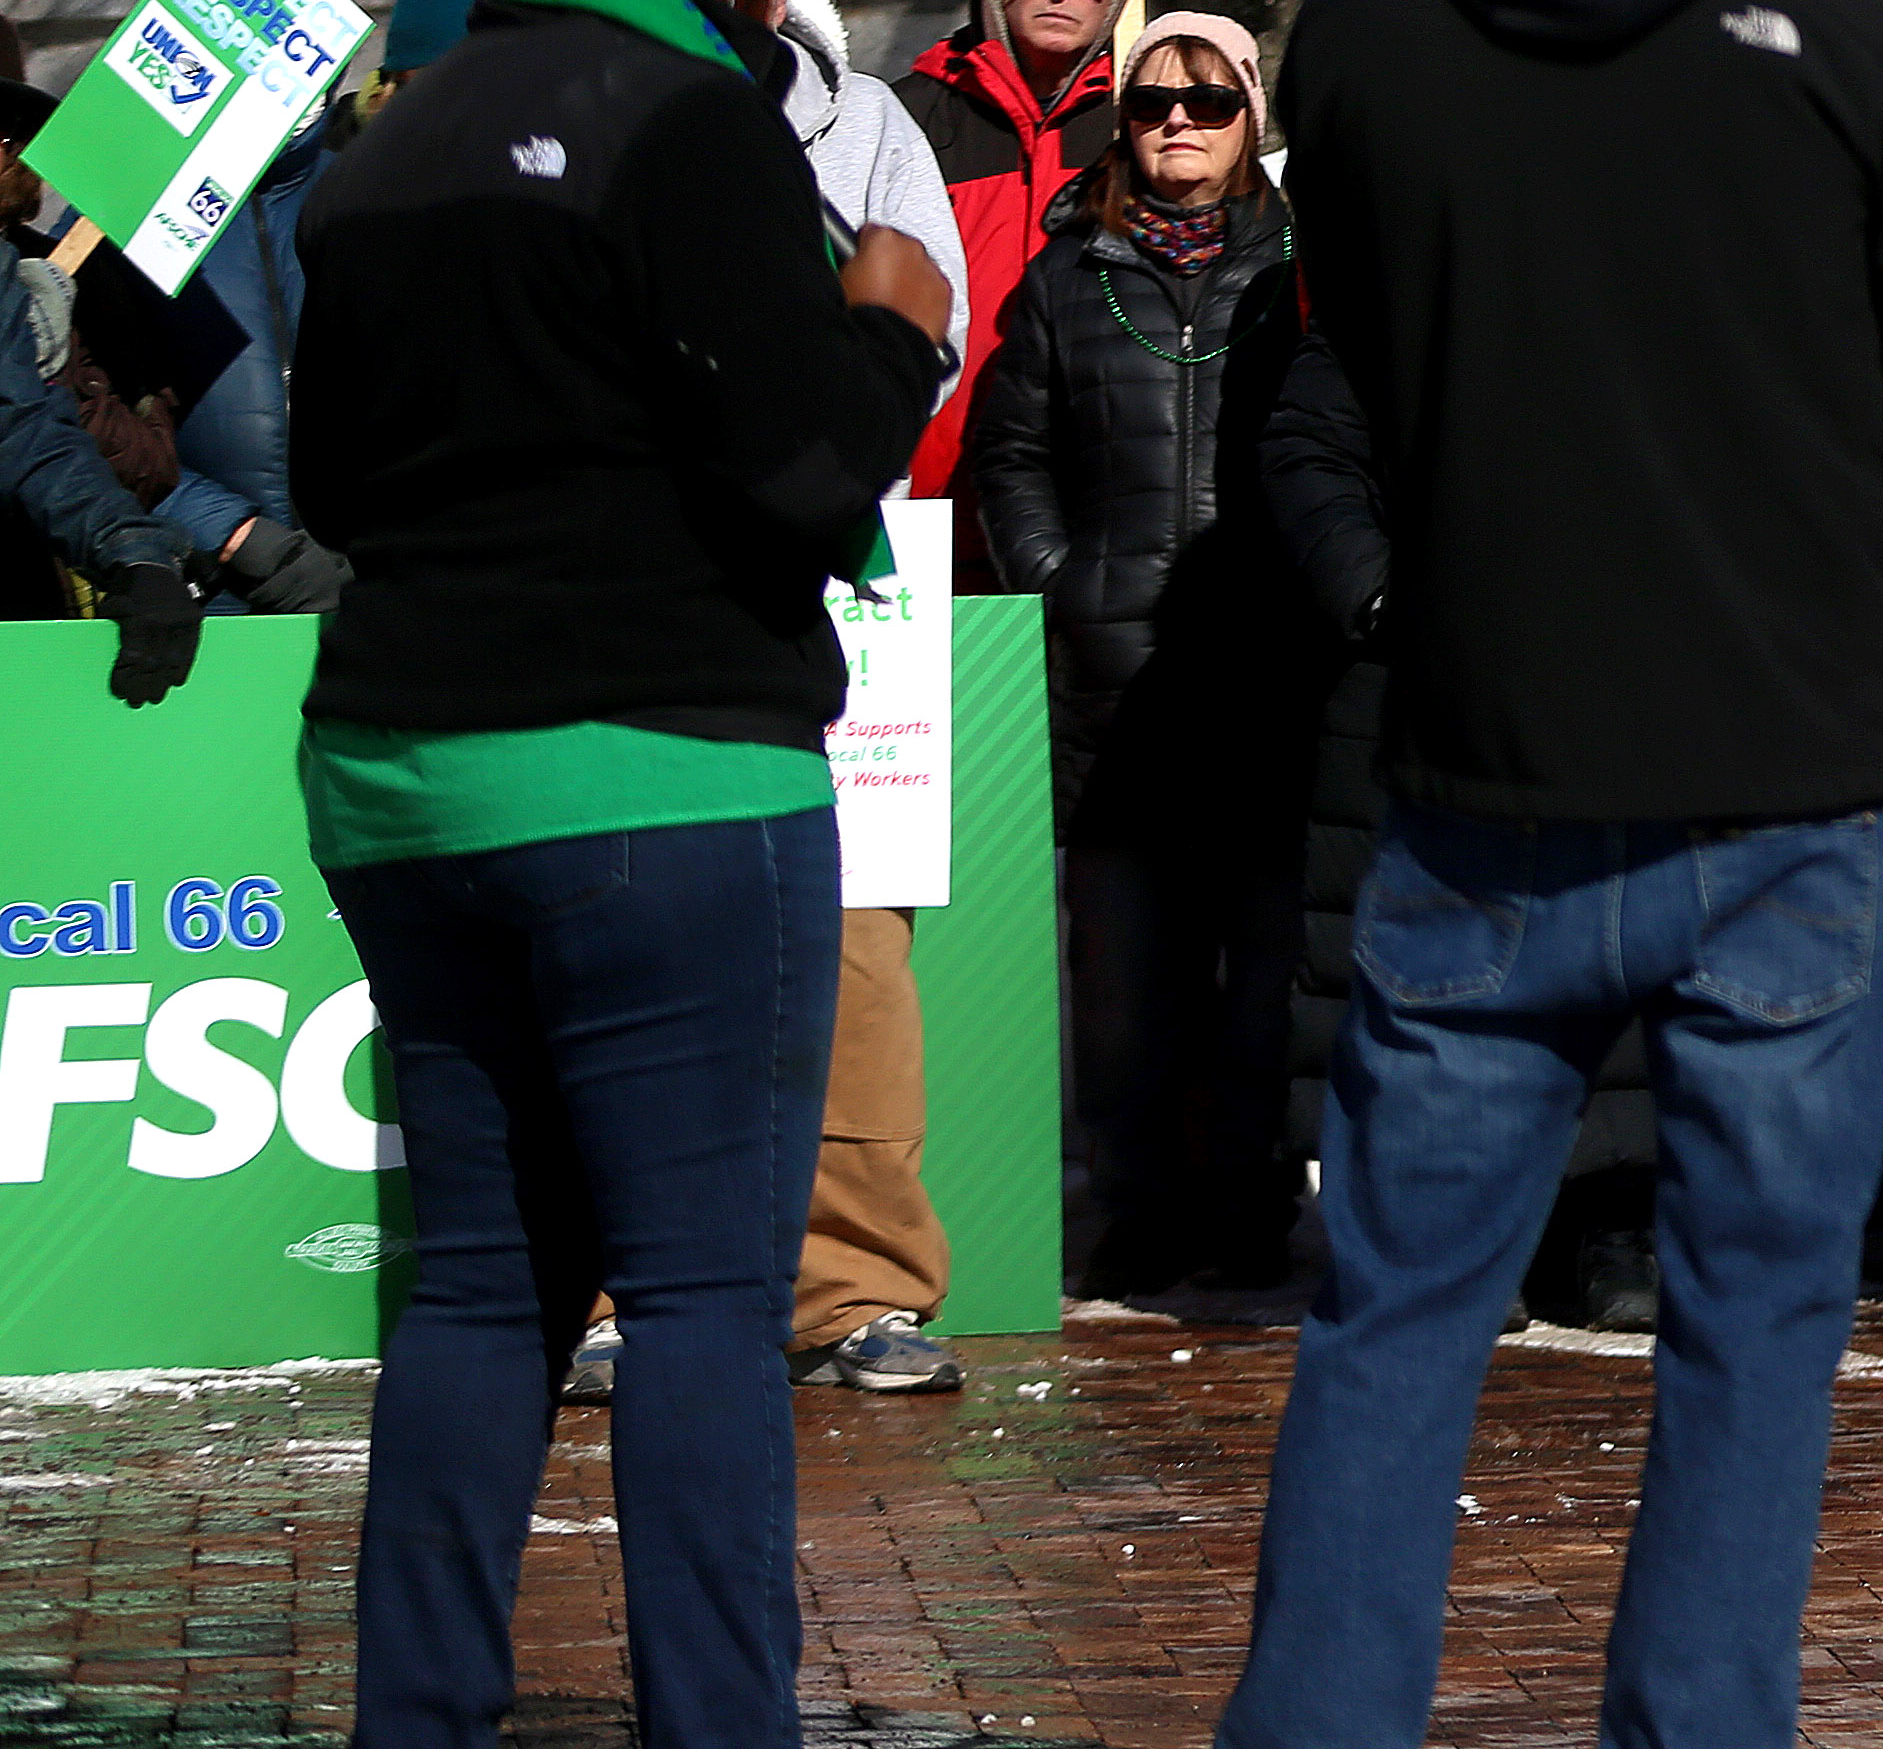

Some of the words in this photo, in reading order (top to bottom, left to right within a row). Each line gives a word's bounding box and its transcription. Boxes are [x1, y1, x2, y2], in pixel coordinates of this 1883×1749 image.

[126, 46, 170, 92] YES
[190, 189, 225, 226] 66
[154, 211, 201, 252] AFSCME
[846, 719, 932, 741] Supports
[826, 747, 865, 762] ocal
[872, 745, 897, 762] 66
[855, 770, 931, 788] Workers
[0, 880, 134, 958] cal
[166, 875, 285, 951] 66
[0, 976, 407, 1186] FSC
